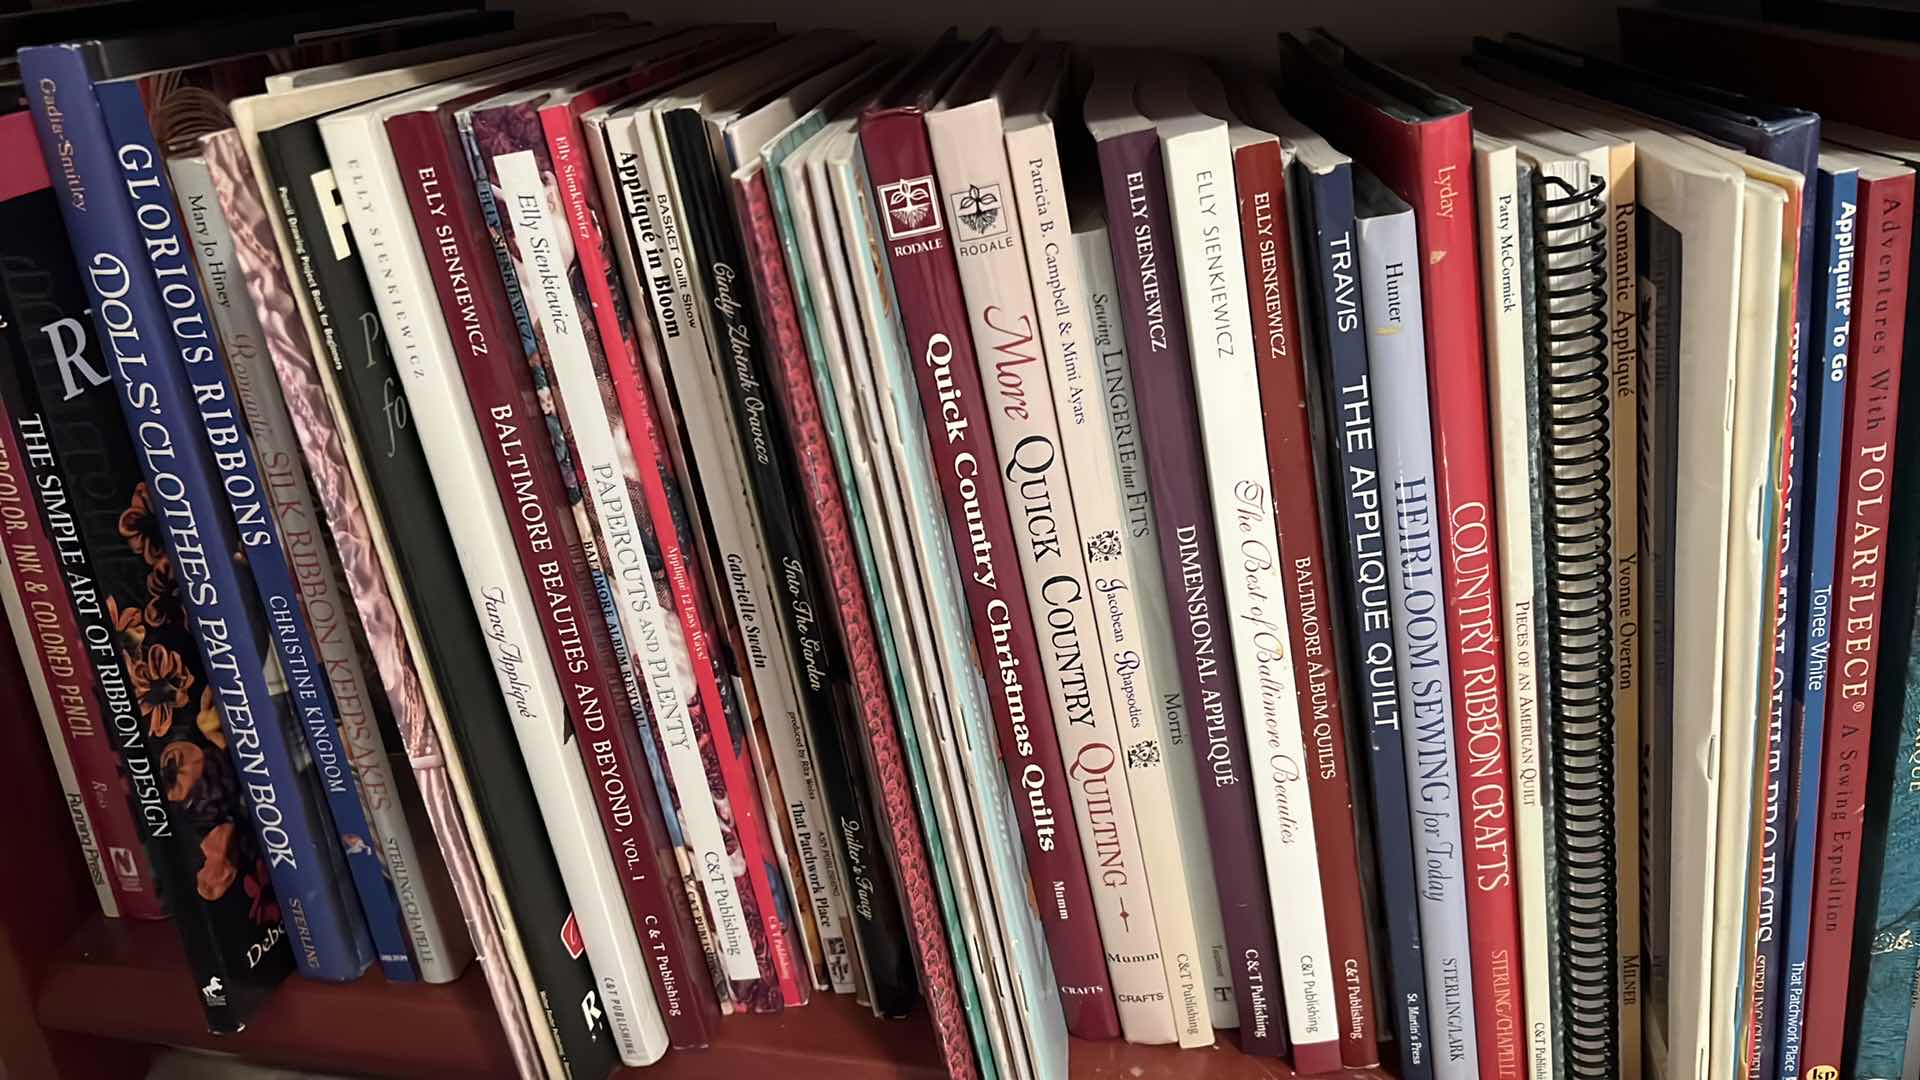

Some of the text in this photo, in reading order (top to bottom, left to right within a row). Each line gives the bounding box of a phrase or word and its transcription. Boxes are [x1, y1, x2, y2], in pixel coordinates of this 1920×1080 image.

[347, 158, 374, 213] ELLY
[555, 135, 590, 240] Elly Sienkiewicz
[1436, 165, 1458, 219] Lyday
[188, 194, 231, 309] Mary Jo Hiney
[299, 256, 317, 288] Project
[418, 166, 489, 357] ELLY SIENKIEWICZ
[517, 193, 569, 336] Elly Sienkiewicz
[620, 152, 681, 339] Appliqué in Bloom
[657, 194, 698, 329] BASKET Show
[895, 239, 943, 258] RODALE
[960, 236, 1014, 257] RODALE
[1028, 157, 1086, 426] Patricia B. Campbell & Mimi Ayars
[1127, 171, 1167, 353] ELLY SIENKIEWICZ
[1195, 170, 1236, 360] ELLY SIENKIEWICZ
[1254, 191, 1288, 360] ELLY SIENKIEWICZ
[1385, 262, 1404, 323] Hunter
[1499, 193, 1518, 313] Patty McCormick
[118, 143, 272, 548] GLORIOUS RIBBONS
[1611, 202, 1636, 398] Romantic Appliqué
[1831, 320, 1850, 382] To Go
[727, 323, 751, 396] Zlotnik
[18, 413, 55, 468] THE
[1092, 291, 1150, 539] Sewing LINGERIE that FITS
[36, 474, 85, 566] SIMPLE
[1329, 232, 1400, 731] TRAVIS THE APPLIQUE QUILT
[591, 463, 651, 613] PAPERCUTS
[1824, 198, 1902, 933] Adventures With A Sewing Expedition
[12, 544, 94, 738] INK COLORED PENCIL
[67, 571, 102, 618] ART
[85, 624, 118, 656] OF
[139, 421, 298, 870] CLOTHES PATTERN BOOK
[264, 451, 392, 811] SILK RIBBON KEEPSAKES
[491, 404, 640, 871] BALTIMORE BEAUTIES AND BEYOND, VOL.
[583, 541, 628, 667] BALTIMORE ALBUM
[640, 616, 660, 653] AND
[727, 553, 766, 669] Gabrielle Swain
[782, 555, 827, 692] Into The Garden
[925, 332, 1055, 853] Quick Country Christmas Quilts
[983, 305, 1127, 888] More QUICK COUNTRY QUILTING
[1618, 553, 1637, 691] Yvonne Overton
[1808, 583, 1832, 691] Tonee White
[97, 662, 144, 750] RIBBON
[269, 595, 347, 794] CHRISTINE KINGDOM
[648, 659, 690, 751] PLENTY
[1095, 578, 1142, 729] Jacobean Rhapsodies
[1175, 524, 1240, 788] DIMENSIONAL APPLIQUÉ
[1233, 479, 1299, 846] The Best of Baltimore Beauties
[1294, 555, 1337, 781] BALTIMORE ALBUM QUILTS
[1395, 475, 1454, 903] HEIRLOOM SEWING for Today
[1449, 500, 1510, 893] COUNTRY RIBBON CRAFTS
[1514, 600, 1536, 807] PIECES OF AN AMERICAN QUILT
[1164, 692, 1188, 745] Morris
[128, 757, 173, 839] DESIGN
[704, 851, 742, 957] C&T Publishing
[791, 800, 831, 928] That Patchwork Place
[1053, 880, 1069, 920] Mumm
[289, 897, 320, 968] STERLING
[645, 915, 682, 1017] C Publishing
[1107, 952, 1160, 963] Mumm
[1622, 954, 1640, 1006] MILNER
[1789, 962, 1806, 986] That
[1061, 984, 1104, 995] CRAFTS
[1118, 992, 1165, 1003] CRAFTS
[1176, 953, 1199, 1036] C&T Publishing
[1245, 949, 1267, 1039] C&T Publishing
[1299, 954, 1321, 1034] C&T Publishing
[1344, 958, 1364, 1040] C&T Publishing
[1442, 957, 1465, 1063] STERLING/LARK
[1534, 1022, 1545, 1045] C&T
[1786, 987, 1803, 1043] Patchwork
[1411, 1043, 1422, 1066] Press
[1784, 1045, 1799, 1072] Place
